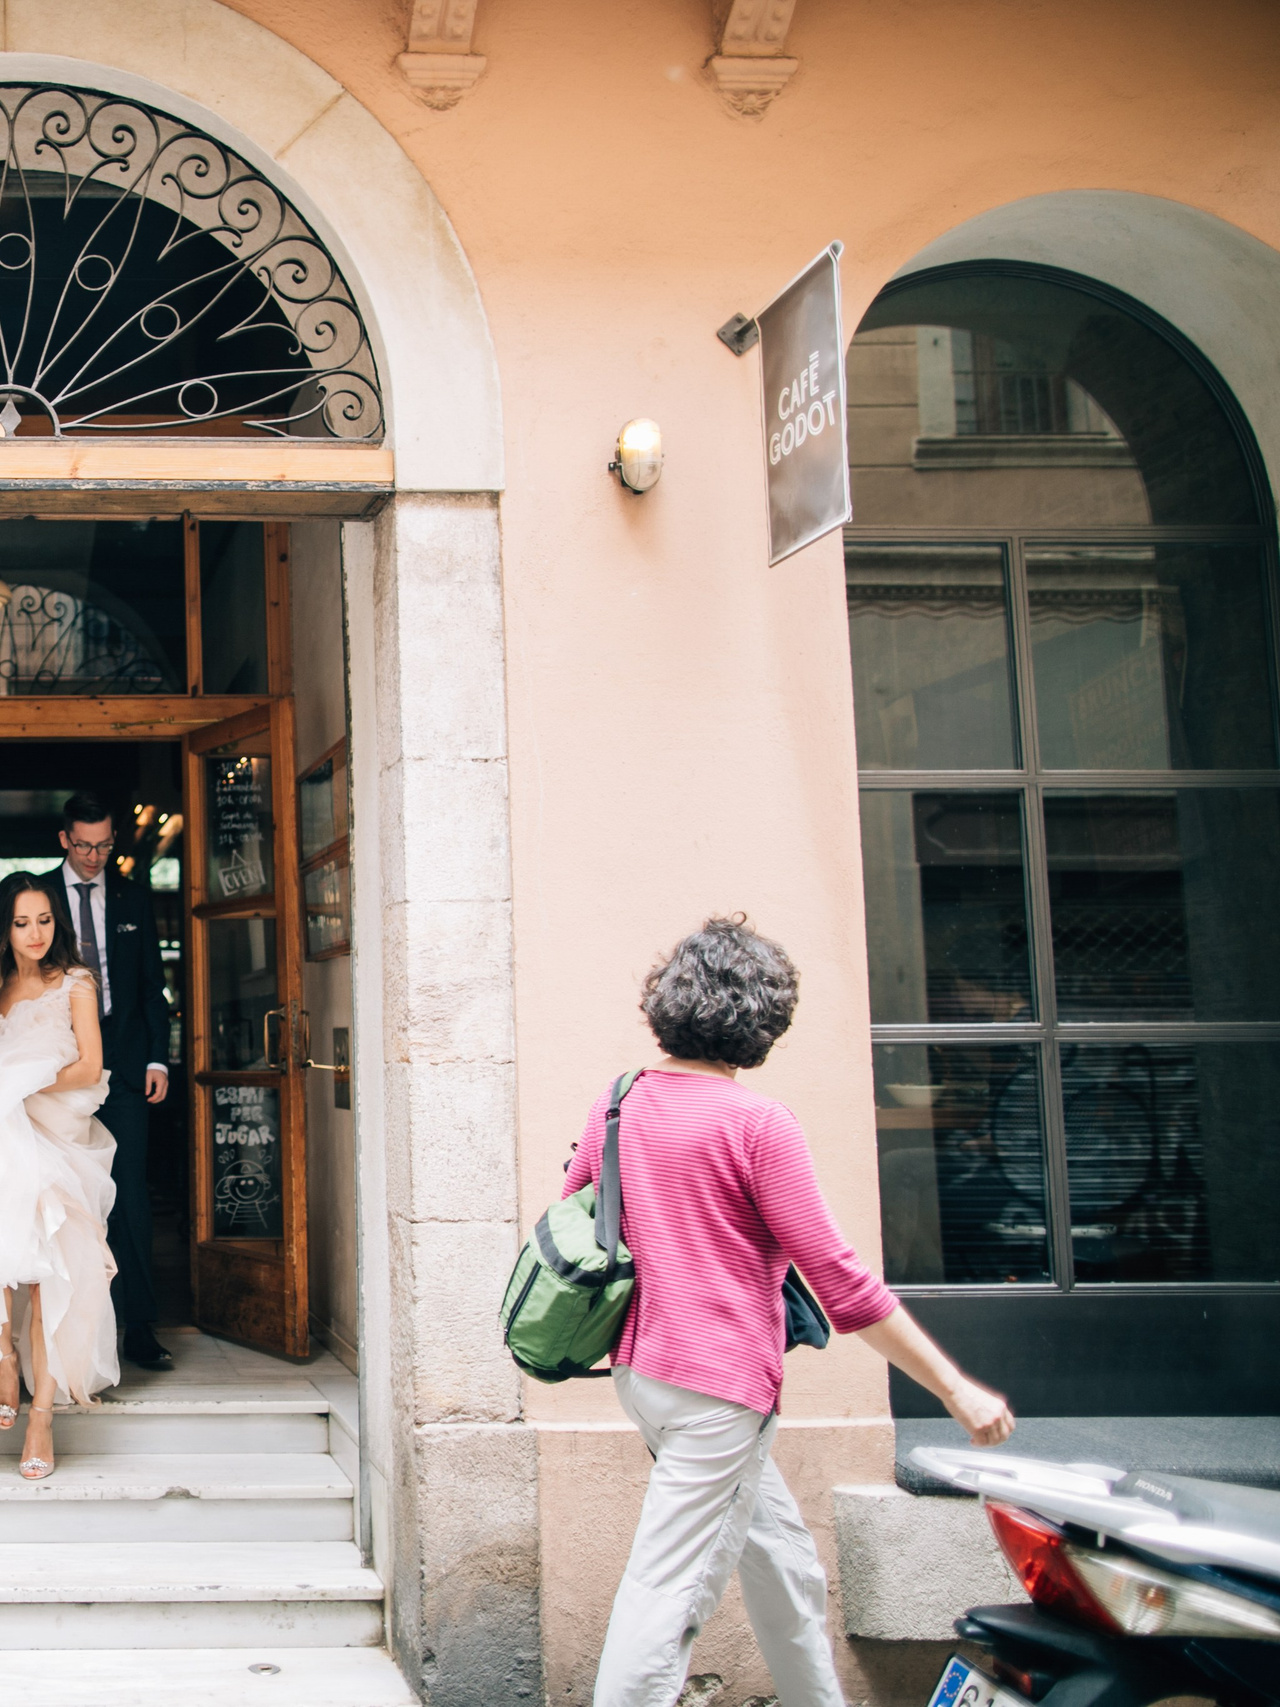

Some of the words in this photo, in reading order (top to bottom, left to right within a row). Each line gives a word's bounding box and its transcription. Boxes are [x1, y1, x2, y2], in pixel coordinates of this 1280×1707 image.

[769, 390, 836, 465] GODOT
[224, 869, 261, 889] OPEN
[231, 1106, 263, 1121] PER
[216, 1123, 274, 1146] JUGAR
[1134, 1479, 1173, 1501] HONDA
